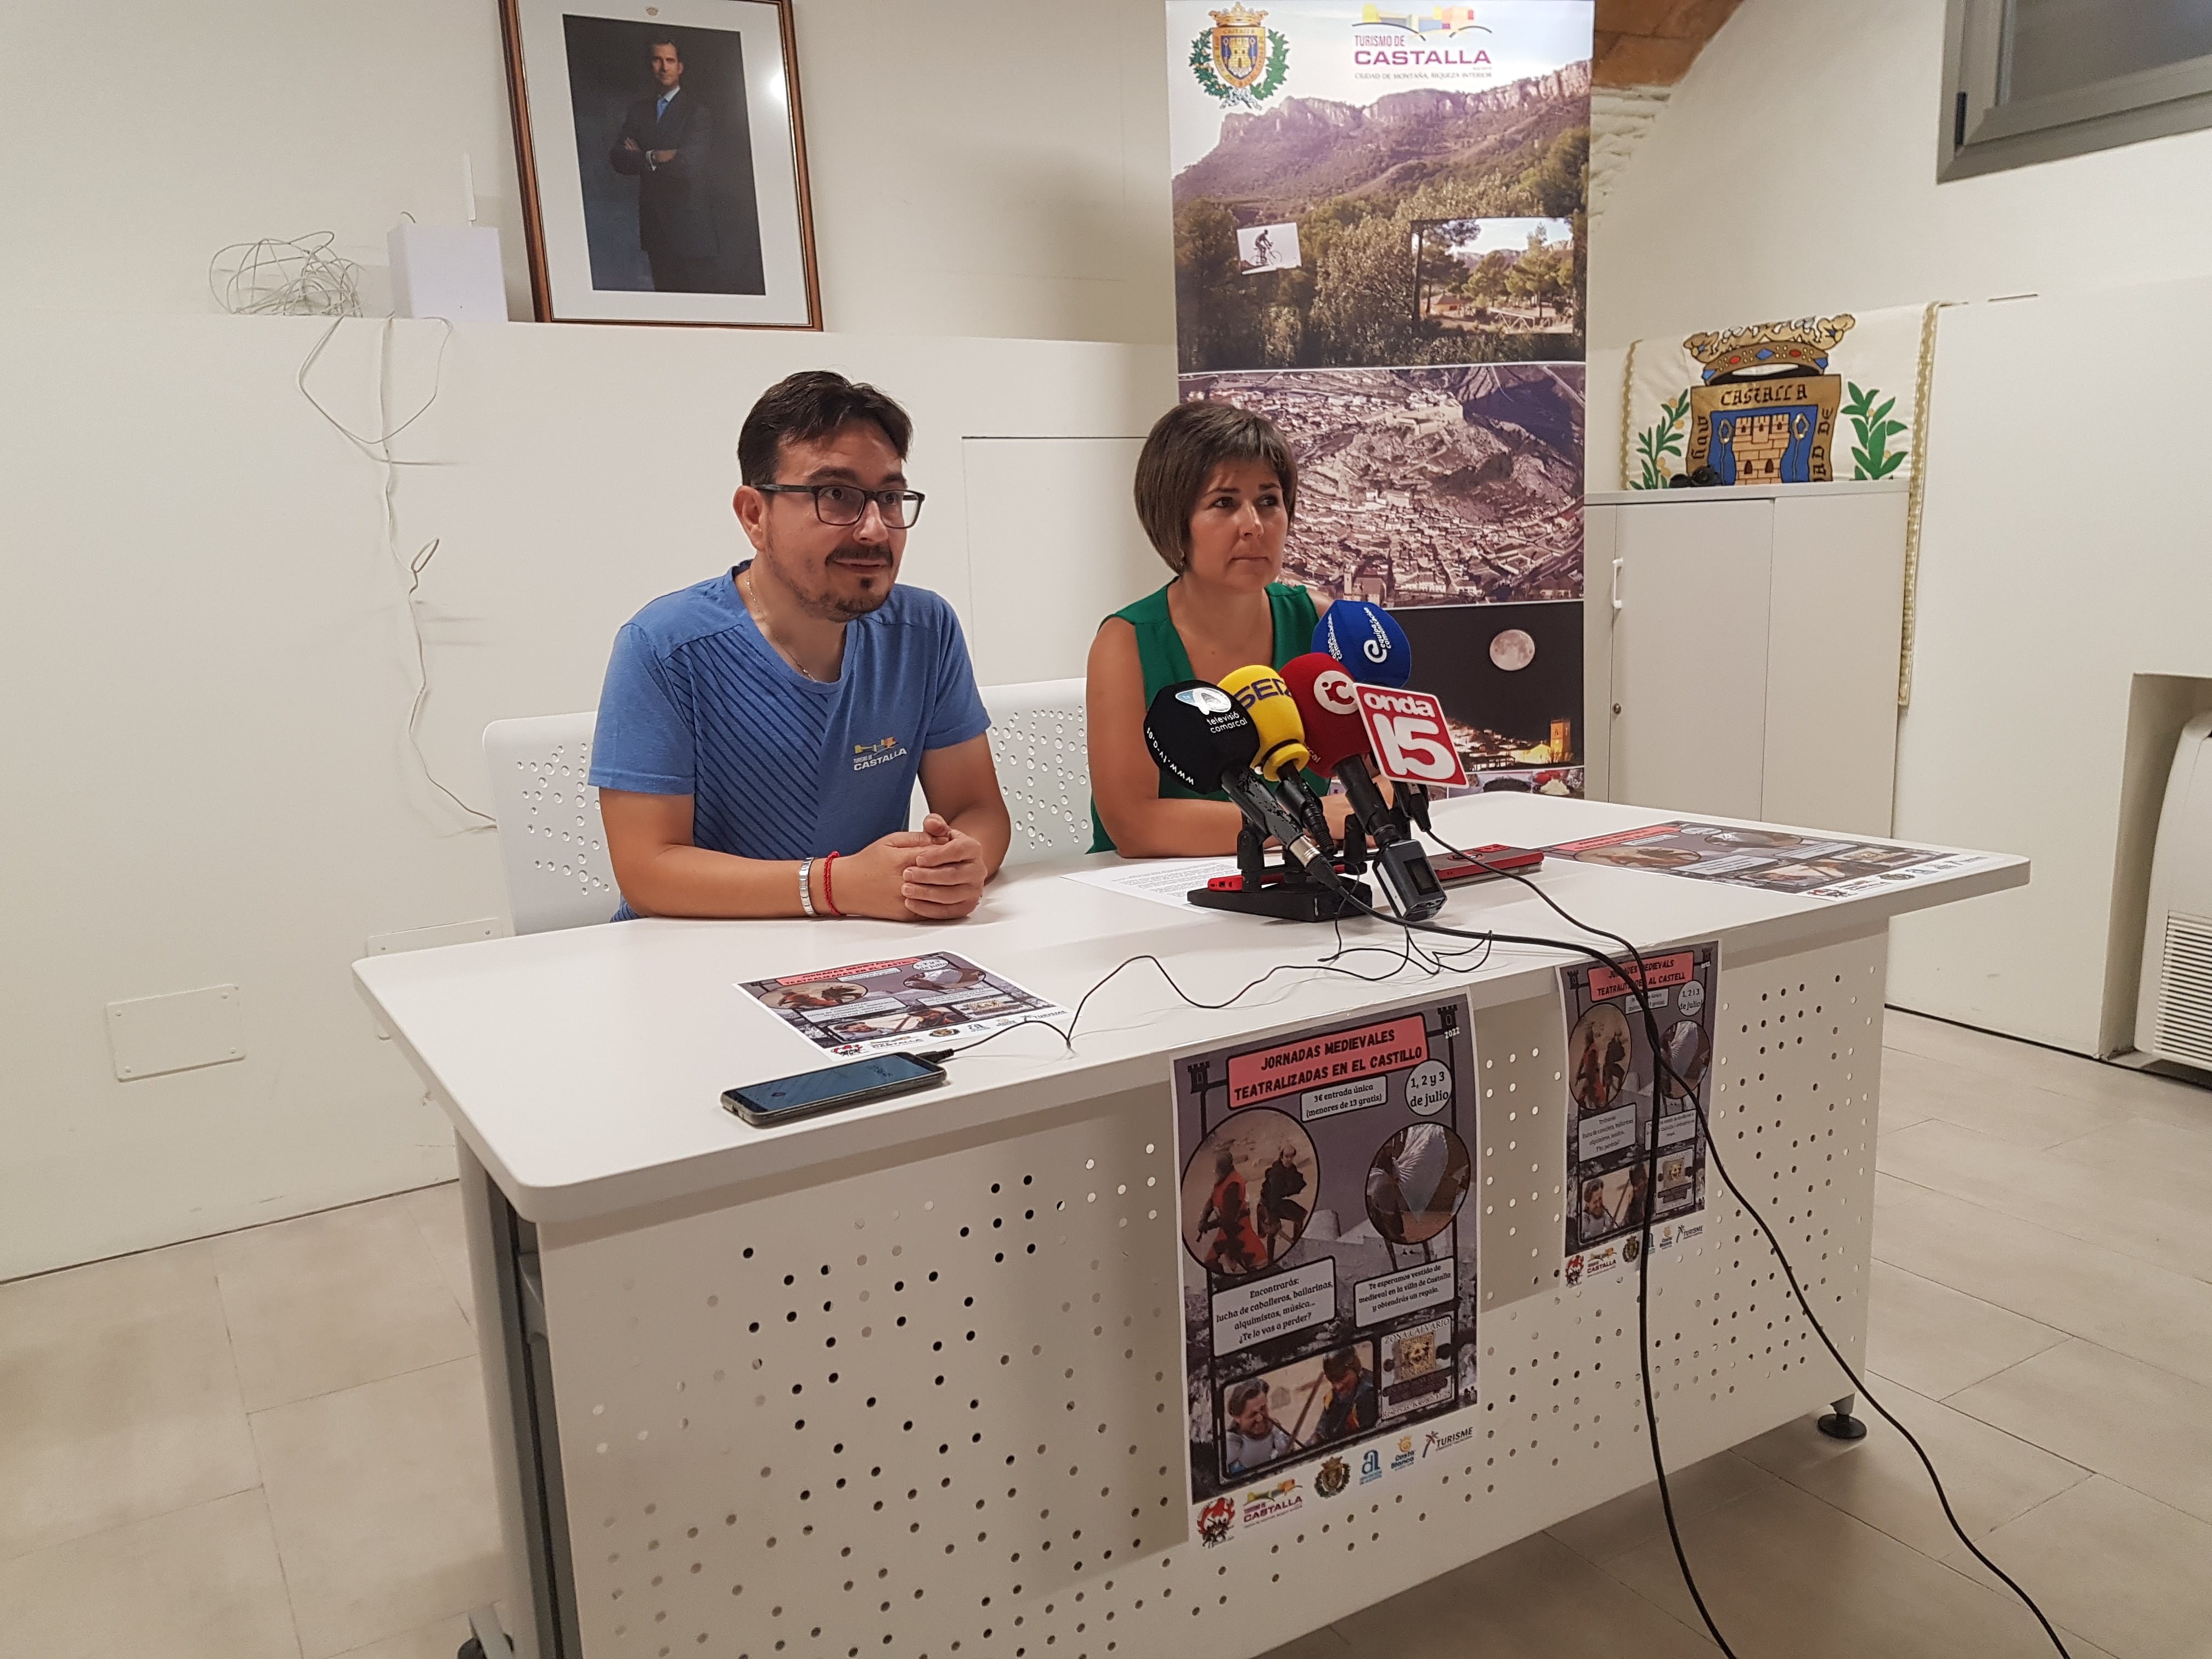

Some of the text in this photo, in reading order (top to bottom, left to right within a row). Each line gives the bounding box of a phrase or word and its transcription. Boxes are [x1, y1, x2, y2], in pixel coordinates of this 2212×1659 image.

[1355, 35, 1404, 46] TURISMO DE
[1354, 50, 1491, 65] CASTALLA
[1363, 692, 1436, 718] onda
[1206, 711, 1240, 725] televisió
[1210, 717, 1248, 733] comarcal
[1372, 713, 1456, 780] 15
[854, 748, 907, 771] CASTALLA
[1649, 977, 1657, 985] AL
[1658, 972, 1685, 984] CASTELL
[1444, 1026, 1460, 1039] 2022
[1260, 1029, 1395, 1071] JORNADAS MEDIEVALES
[1234, 1046, 1423, 1101] TEATRALIZADAS EN EL CASTILLO
[1410, 1071, 1445, 1088] 1, 2 y 3
[1324, 1087, 1352, 1101] entrada
[1353, 1083, 1374, 1095] única
[1410, 1090, 1449, 1108] de julio
[1306, 1093, 1383, 1119] (menores de 13 gratis)
[1587, 1259, 1616, 1274] CASTALLA
[1378, 1274, 1410, 1288] esperamos
[1411, 1267, 1433, 1278] vestido
[1250, 1278, 1299, 1299] Encontrarás:
[1359, 1290, 1387, 1303] medieval
[1404, 1282, 1418, 1291] villa
[1427, 1272, 1451, 1284] Castalla
[1216, 1281, 1334, 1323] lucha de caballeros, bailarinas,
[1378, 1295, 1409, 1309] obtendrás
[1234, 1311, 1282, 1330] alquimistas,
[1283, 1312, 1312, 1329] perder?
[1436, 1427, 1473, 1448] TURISME
[1244, 1496, 1302, 1522] CASTALLA
